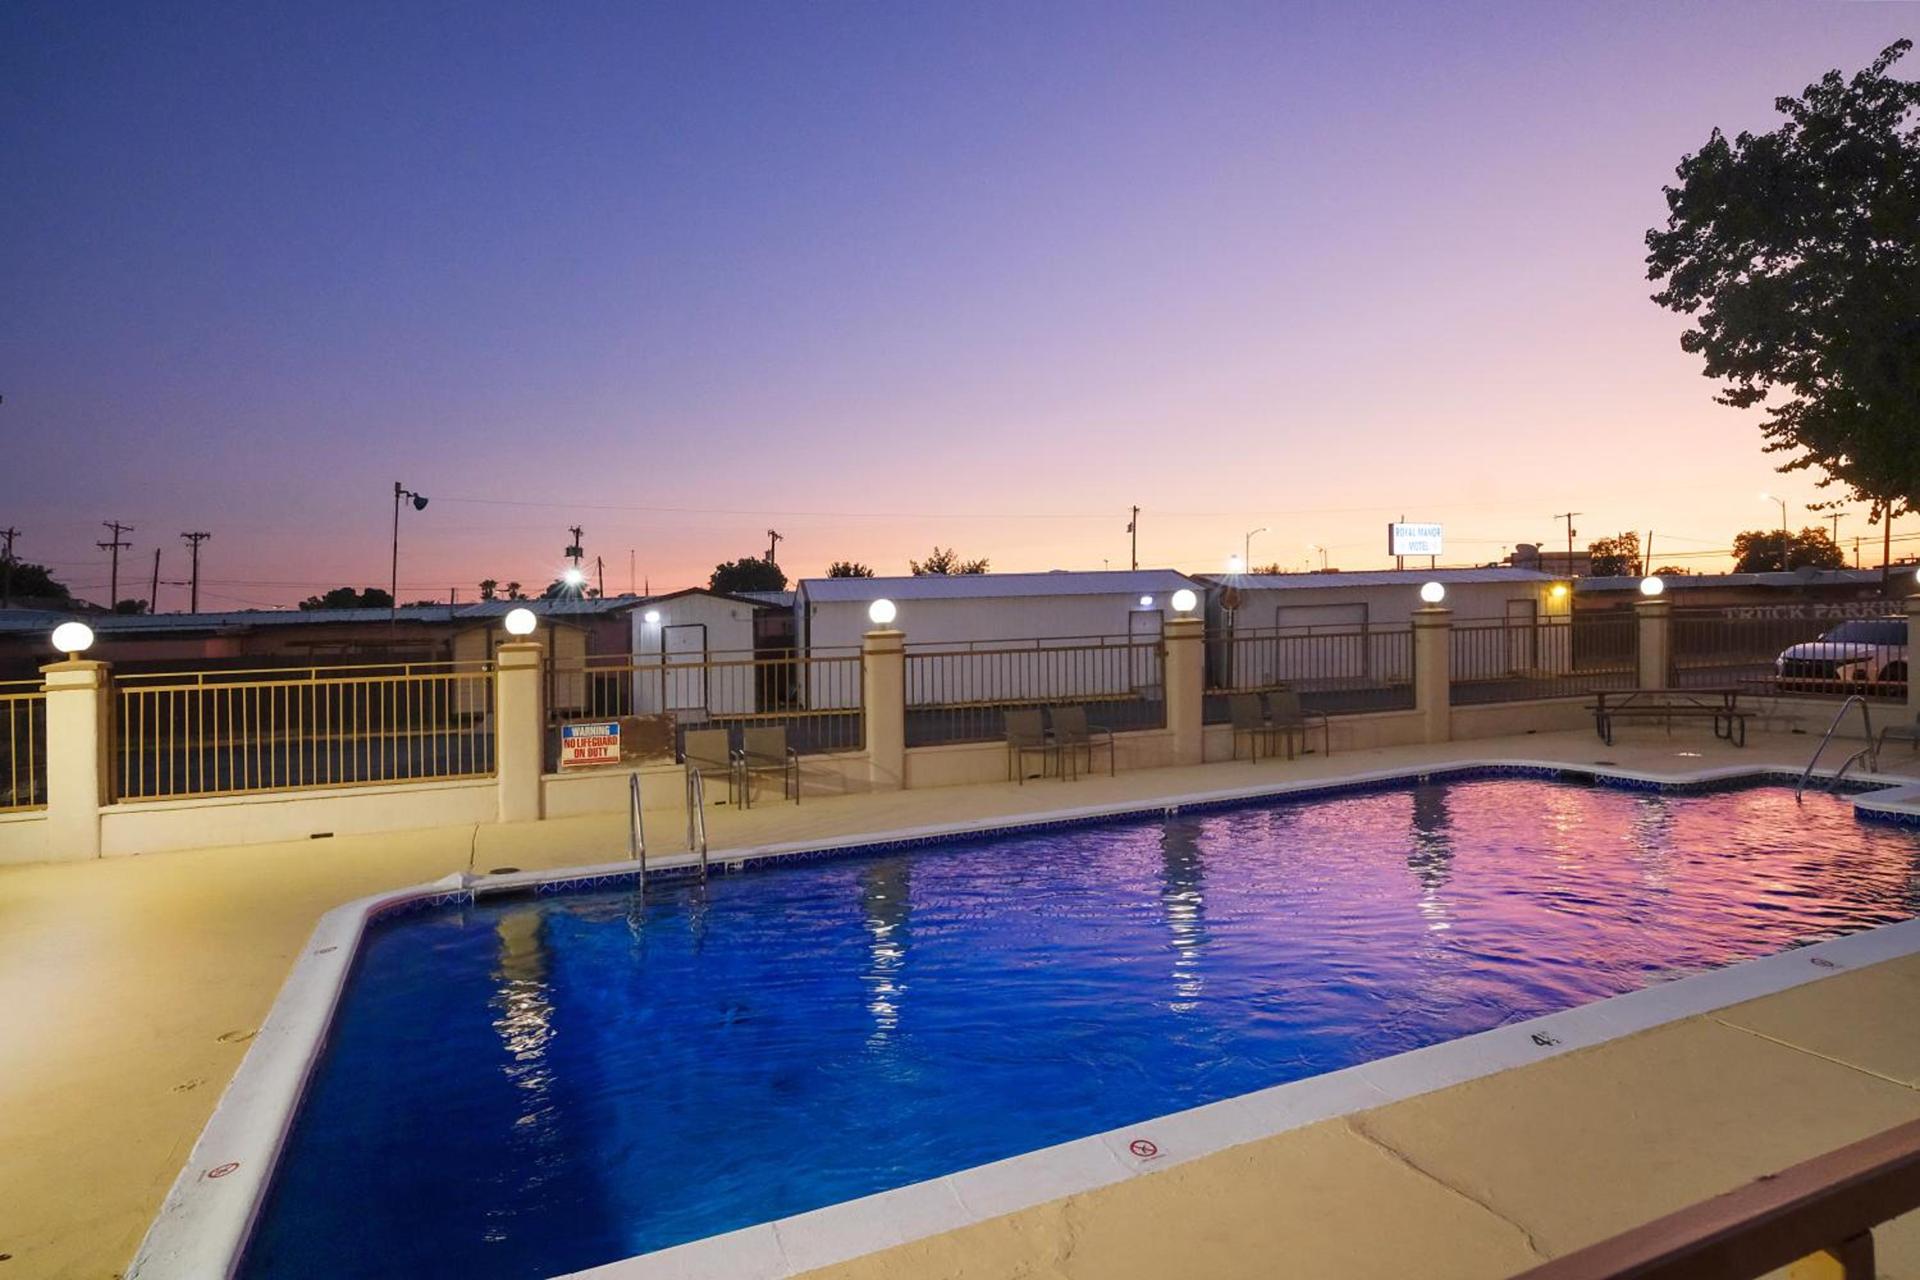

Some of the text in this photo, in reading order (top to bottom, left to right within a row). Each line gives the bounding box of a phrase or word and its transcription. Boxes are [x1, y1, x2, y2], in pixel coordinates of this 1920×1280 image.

[1395, 527, 1441, 537] ROYAL MANOR
[1408, 541, 1429, 552] MOTEL
[1722, 600, 1903, 620] TRUCK PARKIN
[571, 725, 610, 737] WARNING
[564, 736, 618, 749] NO LIFEGUARD
[574, 747, 608, 758] ON DUTY
